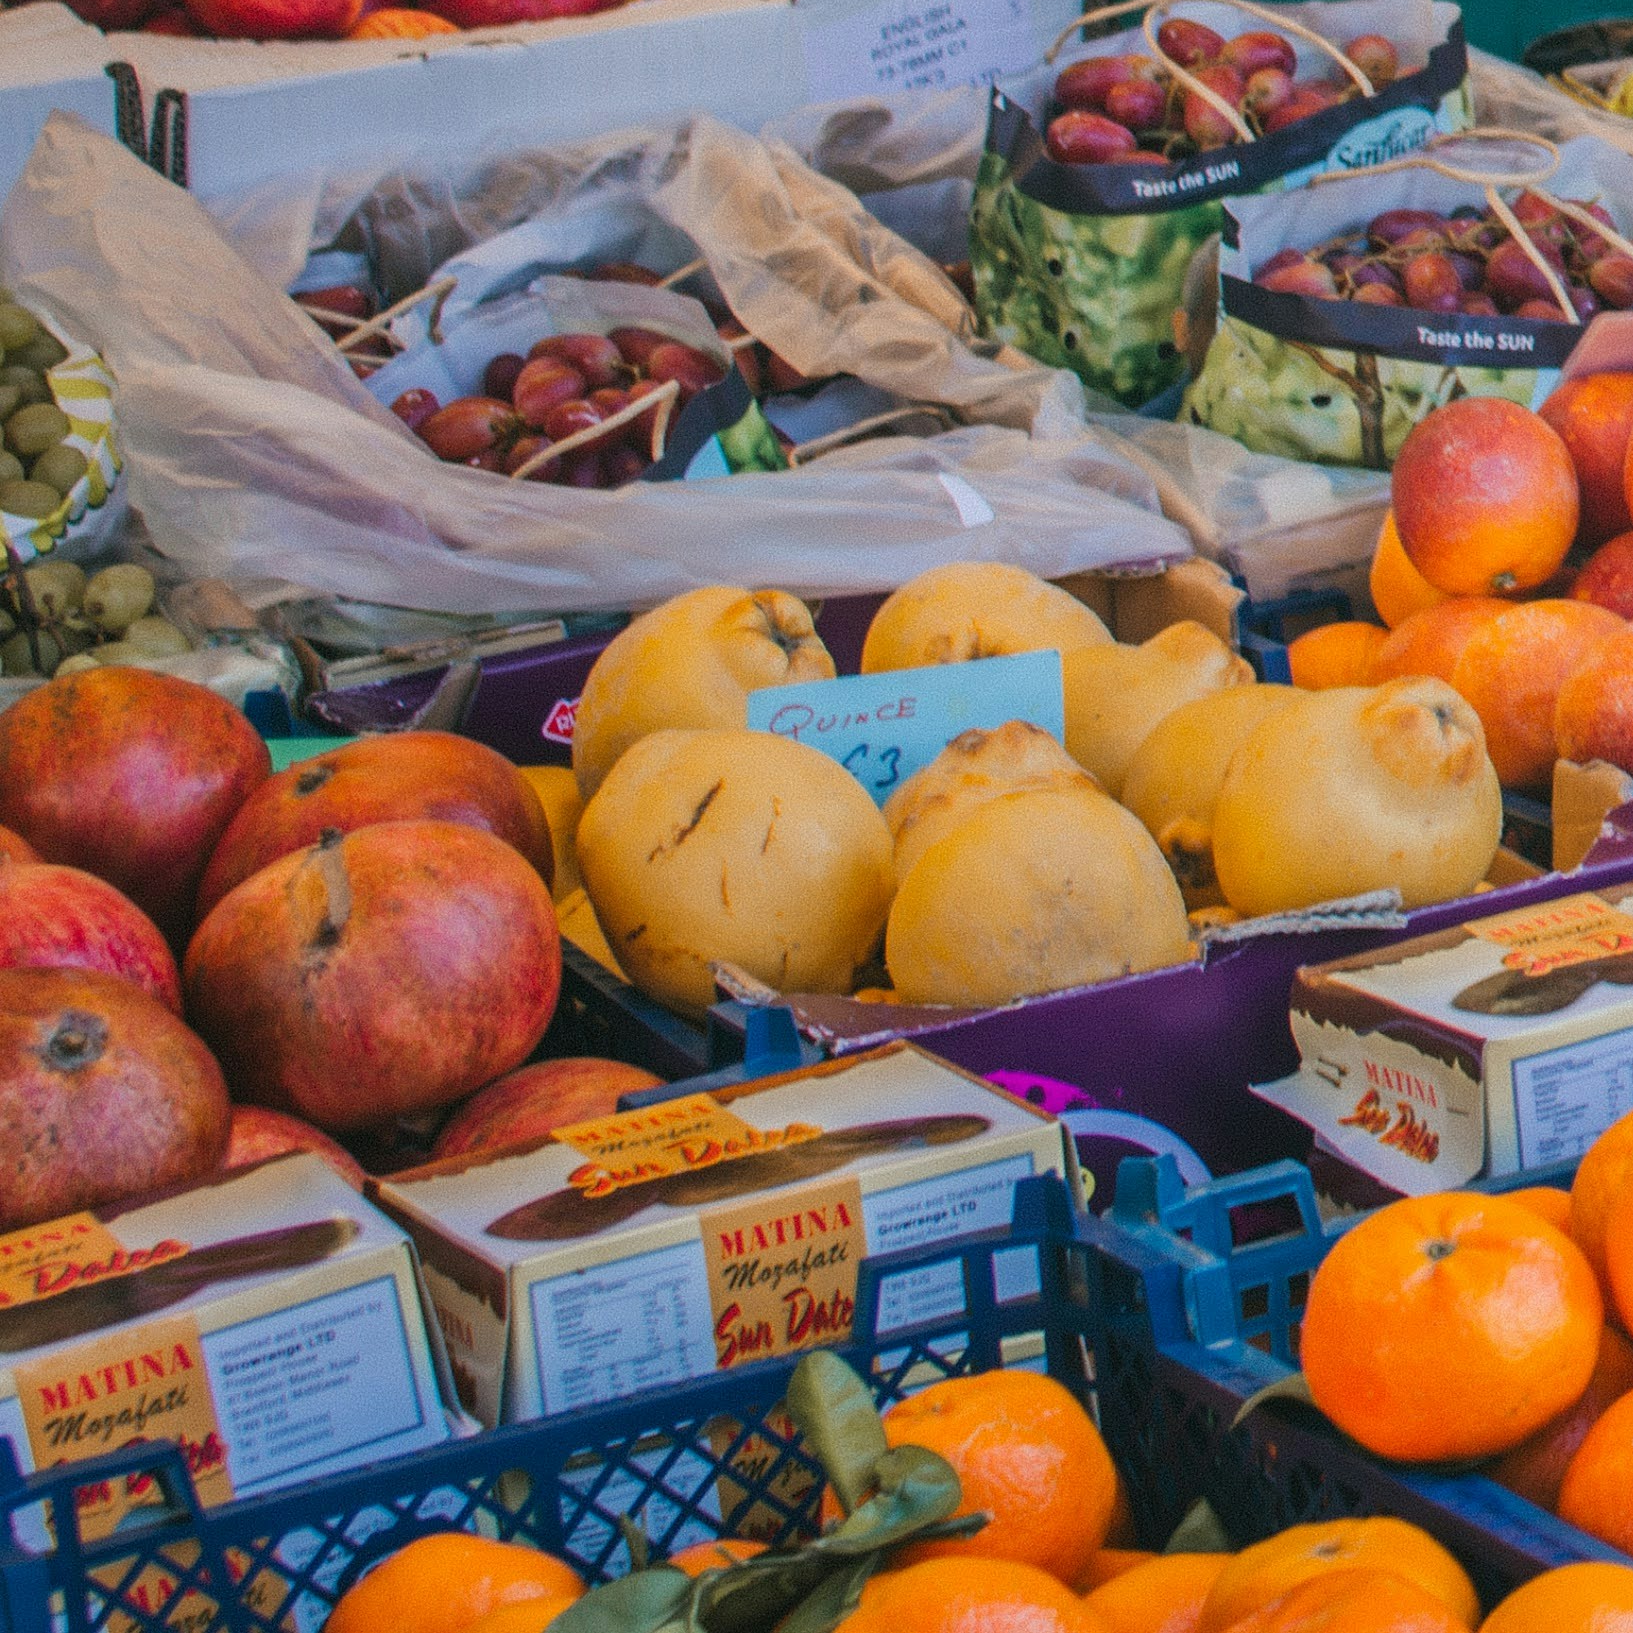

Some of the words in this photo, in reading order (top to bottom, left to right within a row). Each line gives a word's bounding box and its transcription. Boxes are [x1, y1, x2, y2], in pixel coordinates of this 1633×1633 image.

[870, 38, 920, 62] ROYAL
[924, 18, 966, 42] GALA
[881, 5, 951, 40] ENGLISH
[1132, 173, 1174, 200] Taste
[1176, 169, 1203, 194] the
[1204, 161, 1240, 187] SUN
[1416, 326, 1461, 350] Taste
[1463, 329, 1495, 350] the
[1496, 331, 1535, 353] SUN
[769, 696, 918, 741] QUINCE
[1364, 1059, 1438, 1108] MATINA
[575, 1103, 711, 1143] MATINA
[567, 1162, 667, 1199] Sun
[719, 1201, 852, 1260] MATINA
[877, 1210, 949, 1236] Growrange
[951, 1200, 978, 1217] LTD
[722, 1240, 849, 1291] Mozafati
[306, 1328, 337, 1349] LTD
[715, 1301, 774, 1368] Sun
[783, 1286, 854, 1345] Date
[38, 1342, 195, 1415] MATINA
[43, 1383, 189, 1448] Mozafati
